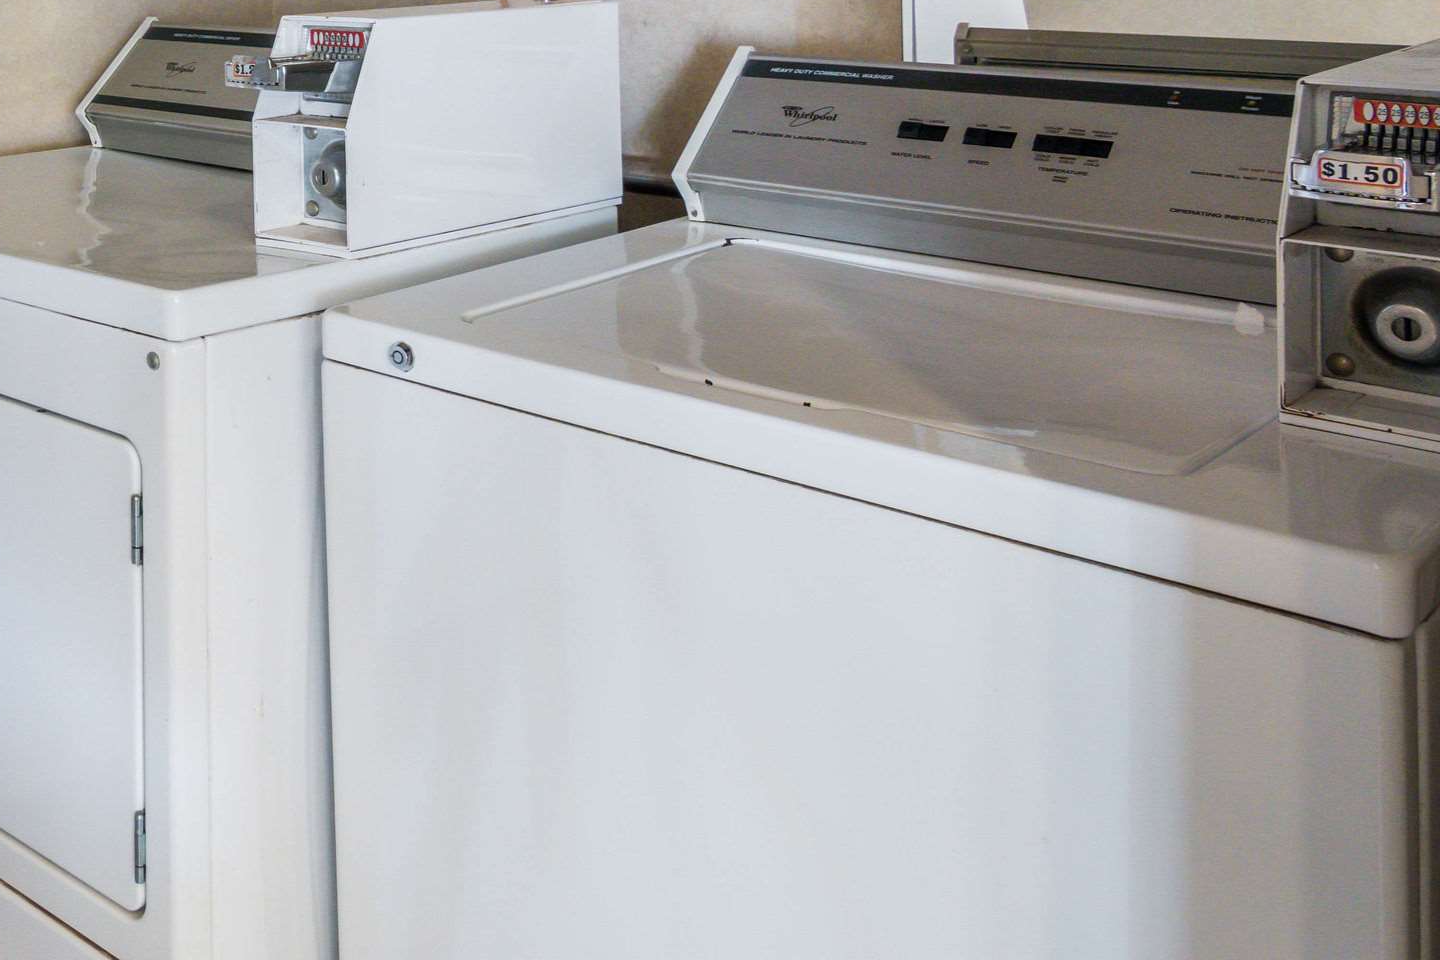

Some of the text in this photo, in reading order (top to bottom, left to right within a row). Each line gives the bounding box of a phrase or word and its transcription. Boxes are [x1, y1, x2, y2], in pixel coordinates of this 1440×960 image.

[234, 64, 255, 75] $1.2
[783, 108, 838, 124] Whirlpool
[1322, 161, 1399, 185] $1.50
[1169, 207, 1222, 219] OPERATING
